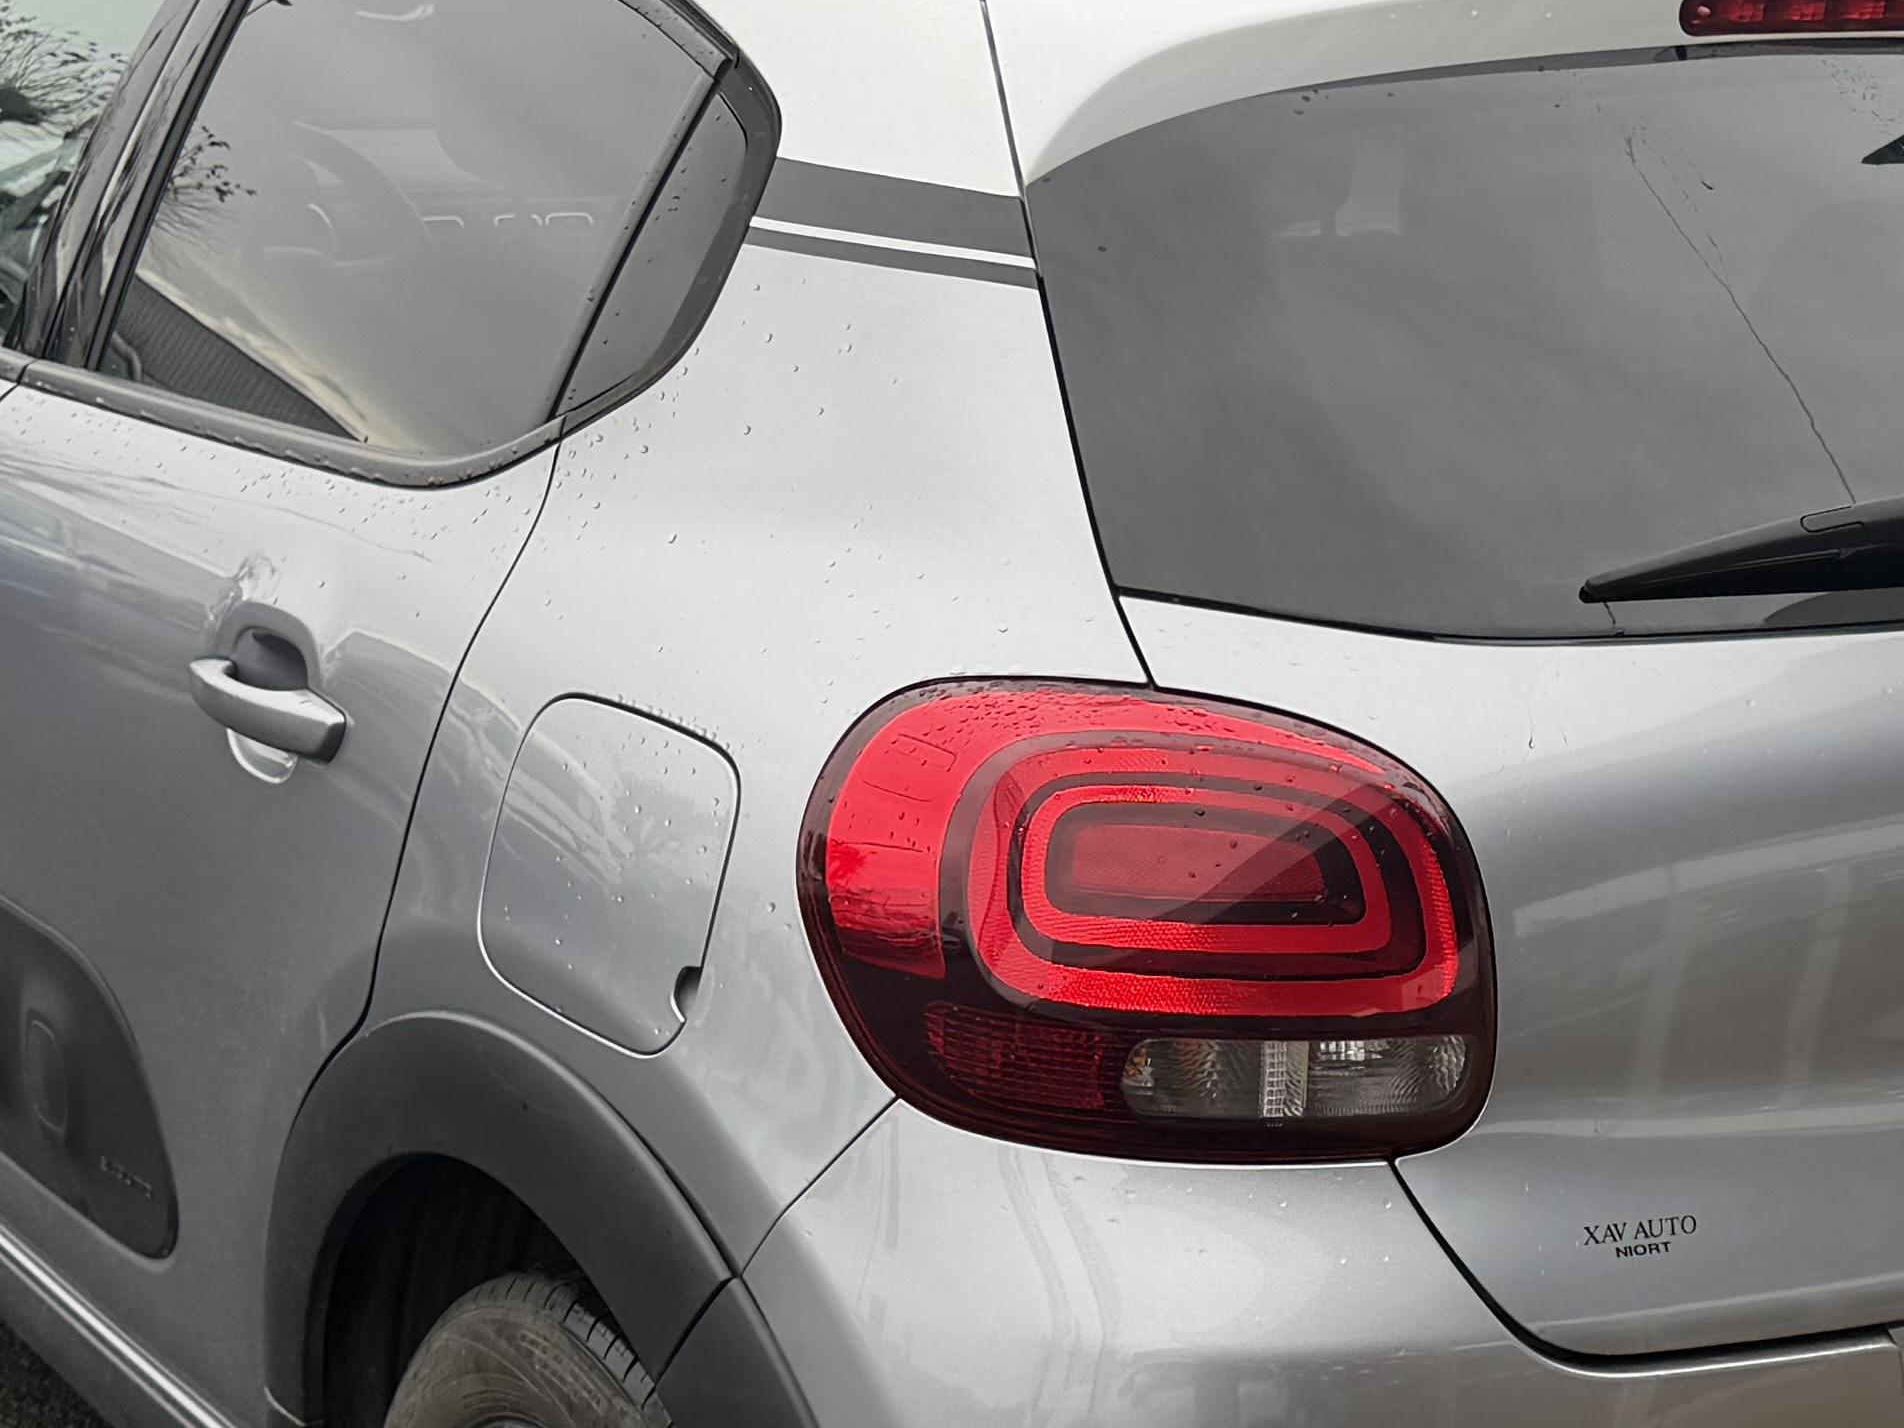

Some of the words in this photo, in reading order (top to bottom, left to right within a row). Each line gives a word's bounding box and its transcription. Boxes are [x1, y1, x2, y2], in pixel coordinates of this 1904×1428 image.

[1583, 1221, 1628, 1246] XAV
[1633, 1214, 1697, 1241] AUTO
[1614, 1240, 1672, 1259] NIORT
